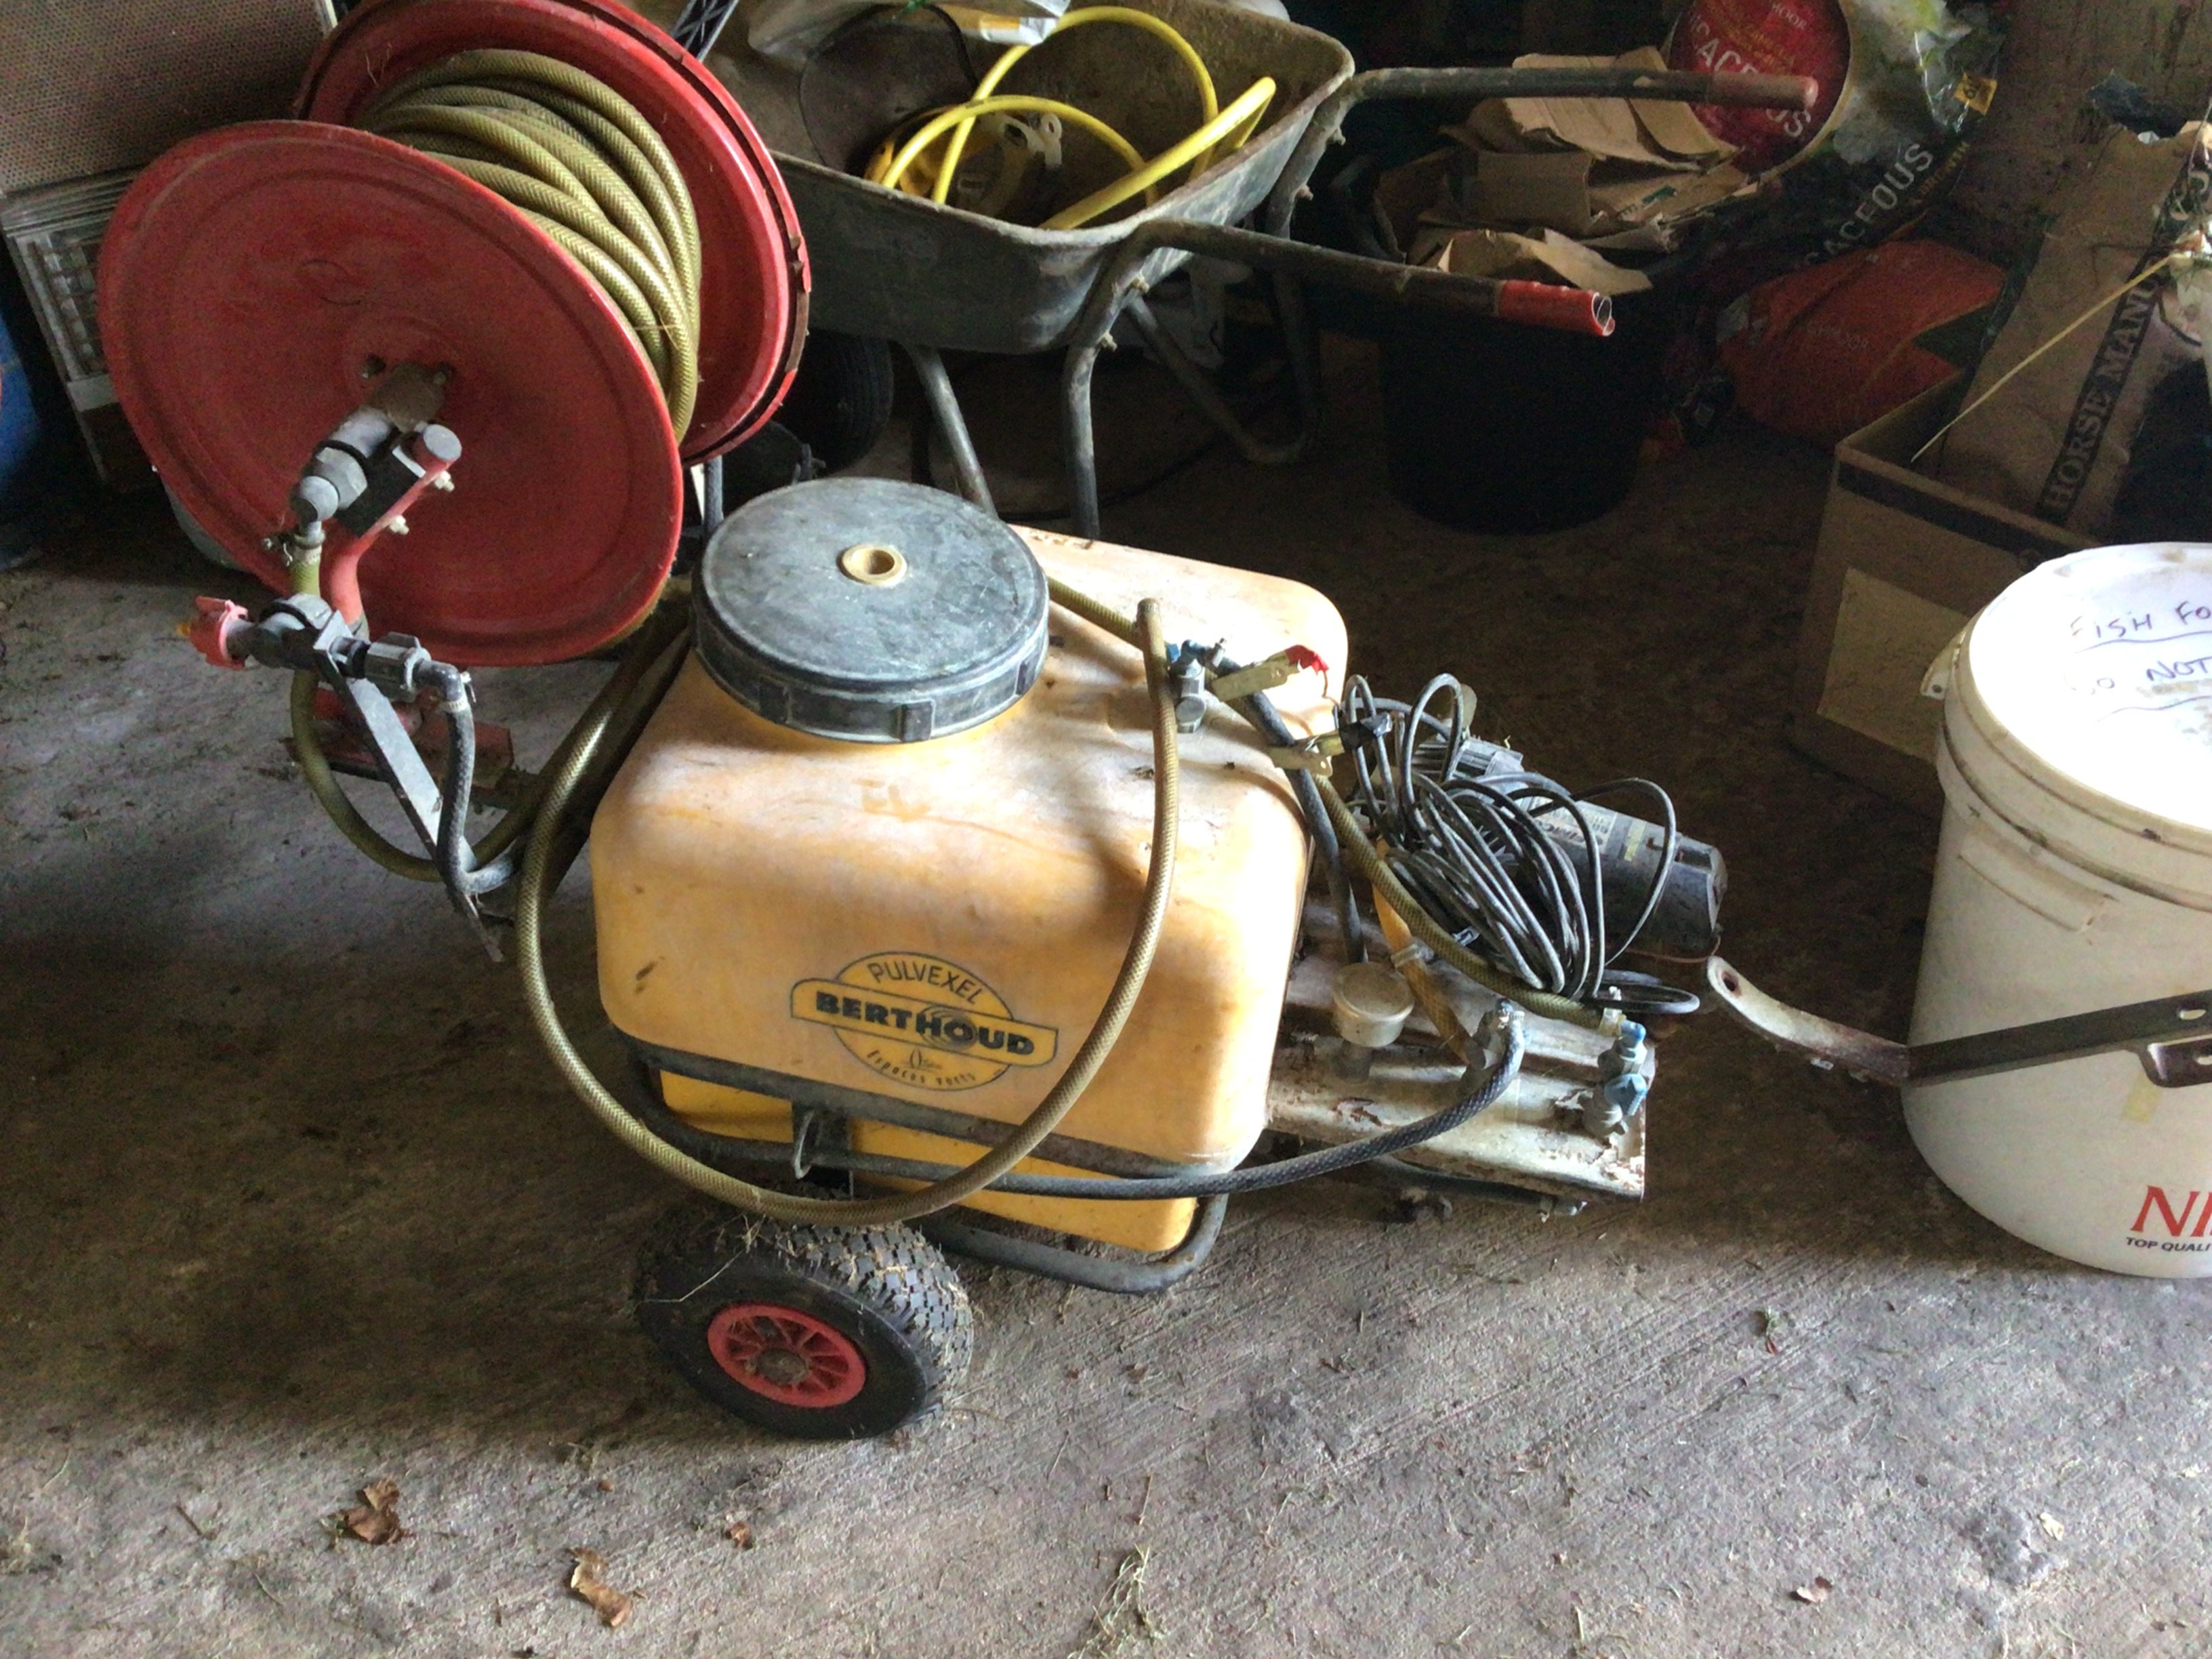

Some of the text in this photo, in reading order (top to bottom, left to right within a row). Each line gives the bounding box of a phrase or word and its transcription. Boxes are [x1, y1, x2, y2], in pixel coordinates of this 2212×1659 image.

[2041, 388, 2114, 513] HORSE
[2070, 613, 2152, 638] FISH
[2146, 655, 2212, 682] NOT
[867, 959, 987, 1006] PULVEXEL
[815, 990, 1036, 1057] BERTHOUD
[2130, 1185, 2212, 1237] NI
[2126, 1237, 2211, 1252] TOP QUALI
